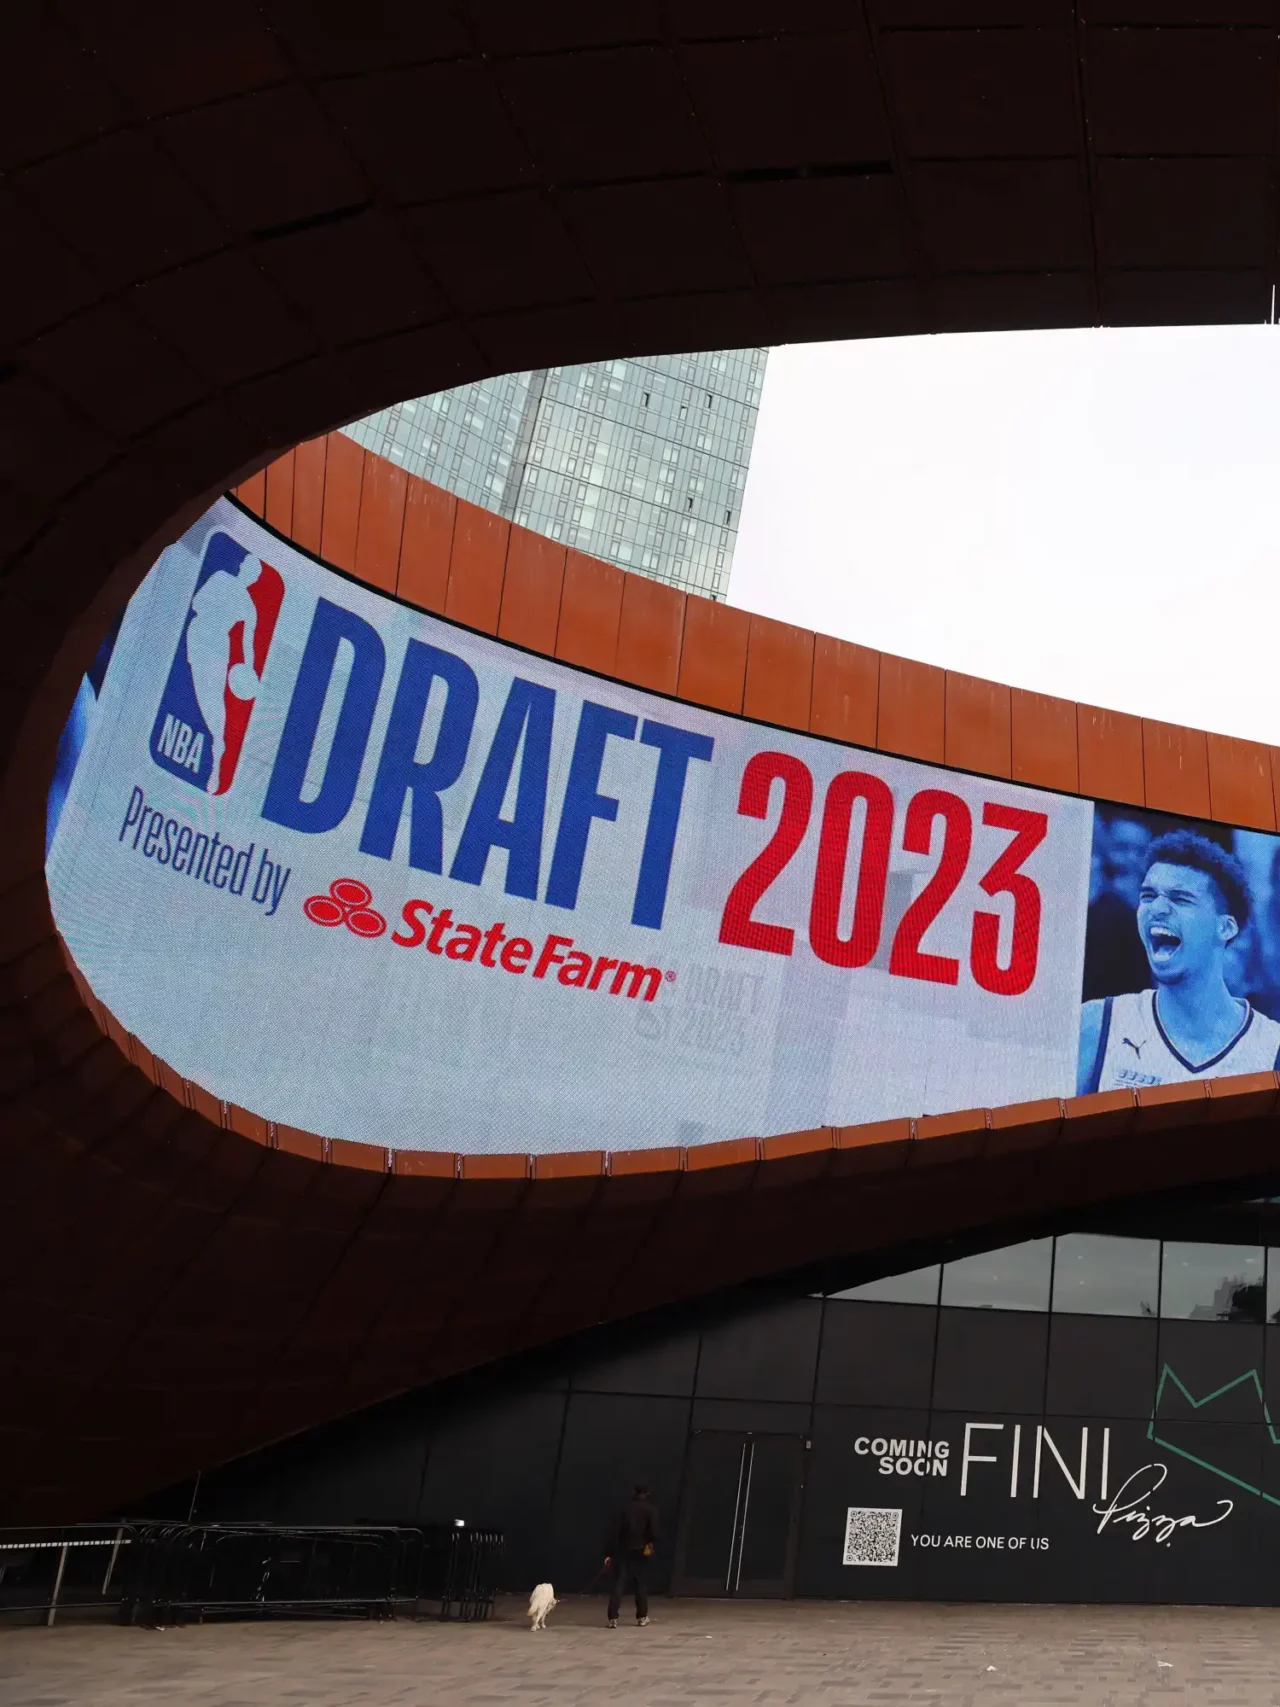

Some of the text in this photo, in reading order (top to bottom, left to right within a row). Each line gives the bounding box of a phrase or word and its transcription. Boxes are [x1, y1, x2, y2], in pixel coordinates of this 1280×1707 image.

[157, 714, 205, 774] NBA
[261, 596, 714, 930] DRAFT
[119, 785, 291, 916] Presented by
[719, 751, 1048, 996] 2023
[854, 1437, 950, 1459] COMING
[878, 1457, 948, 1476] SOON
[960, 1422, 1110, 1500] FINI
[911, 1534, 941, 1547] YOU
[944, 1535, 972, 1548] ARE
[975, 1536, 1005, 1549] ONE
[1008, 1537, 1027, 1549] OF
[1092, 1463, 1234, 1547] Pizza
